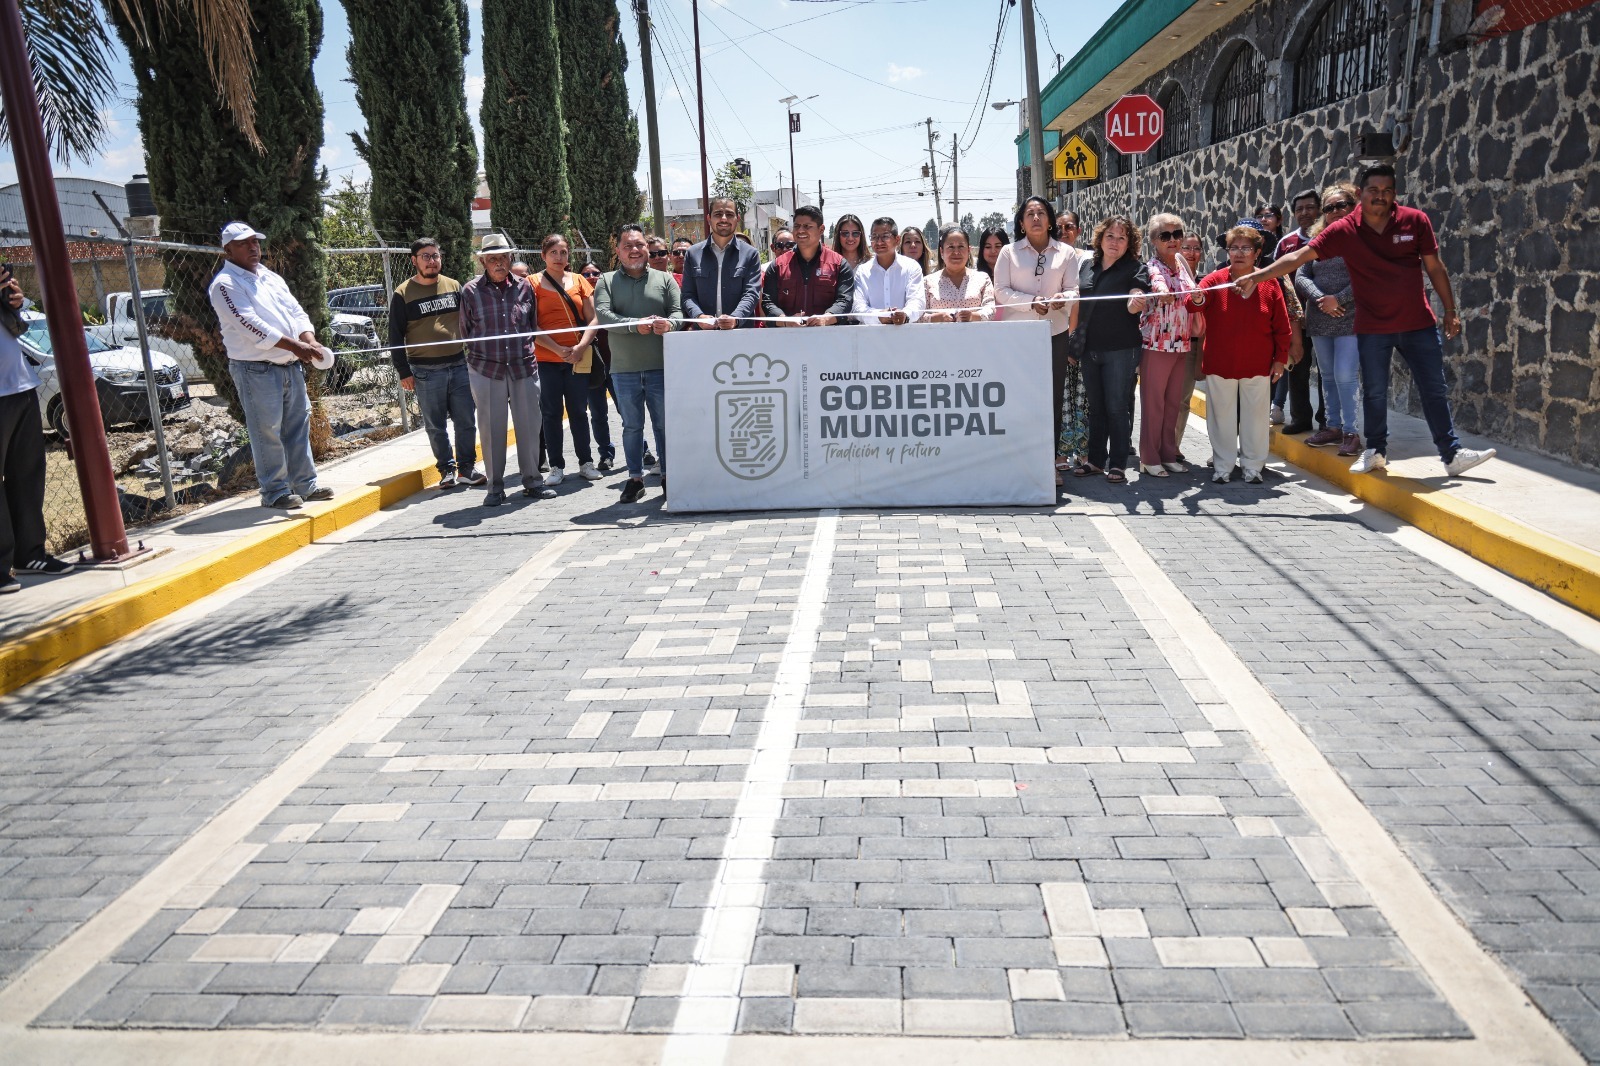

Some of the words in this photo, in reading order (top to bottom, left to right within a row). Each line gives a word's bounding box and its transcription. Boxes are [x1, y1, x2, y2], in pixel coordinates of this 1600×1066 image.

[1109, 112, 1160, 137] ALTO
[219, 285, 268, 340] CUAUTLANCINGO
[819, 370, 919, 381] CUAUTLANCINGO
[921, 370, 948, 379] 2024
[957, 369, 983, 379] 2027
[820, 381, 1006, 411] GOBIERNO
[820, 412, 1006, 438] MUNICIPAL
[821, 442, 880, 464] Tradición
[886, 446, 896, 463] y
[900, 441, 941, 464] futuro
